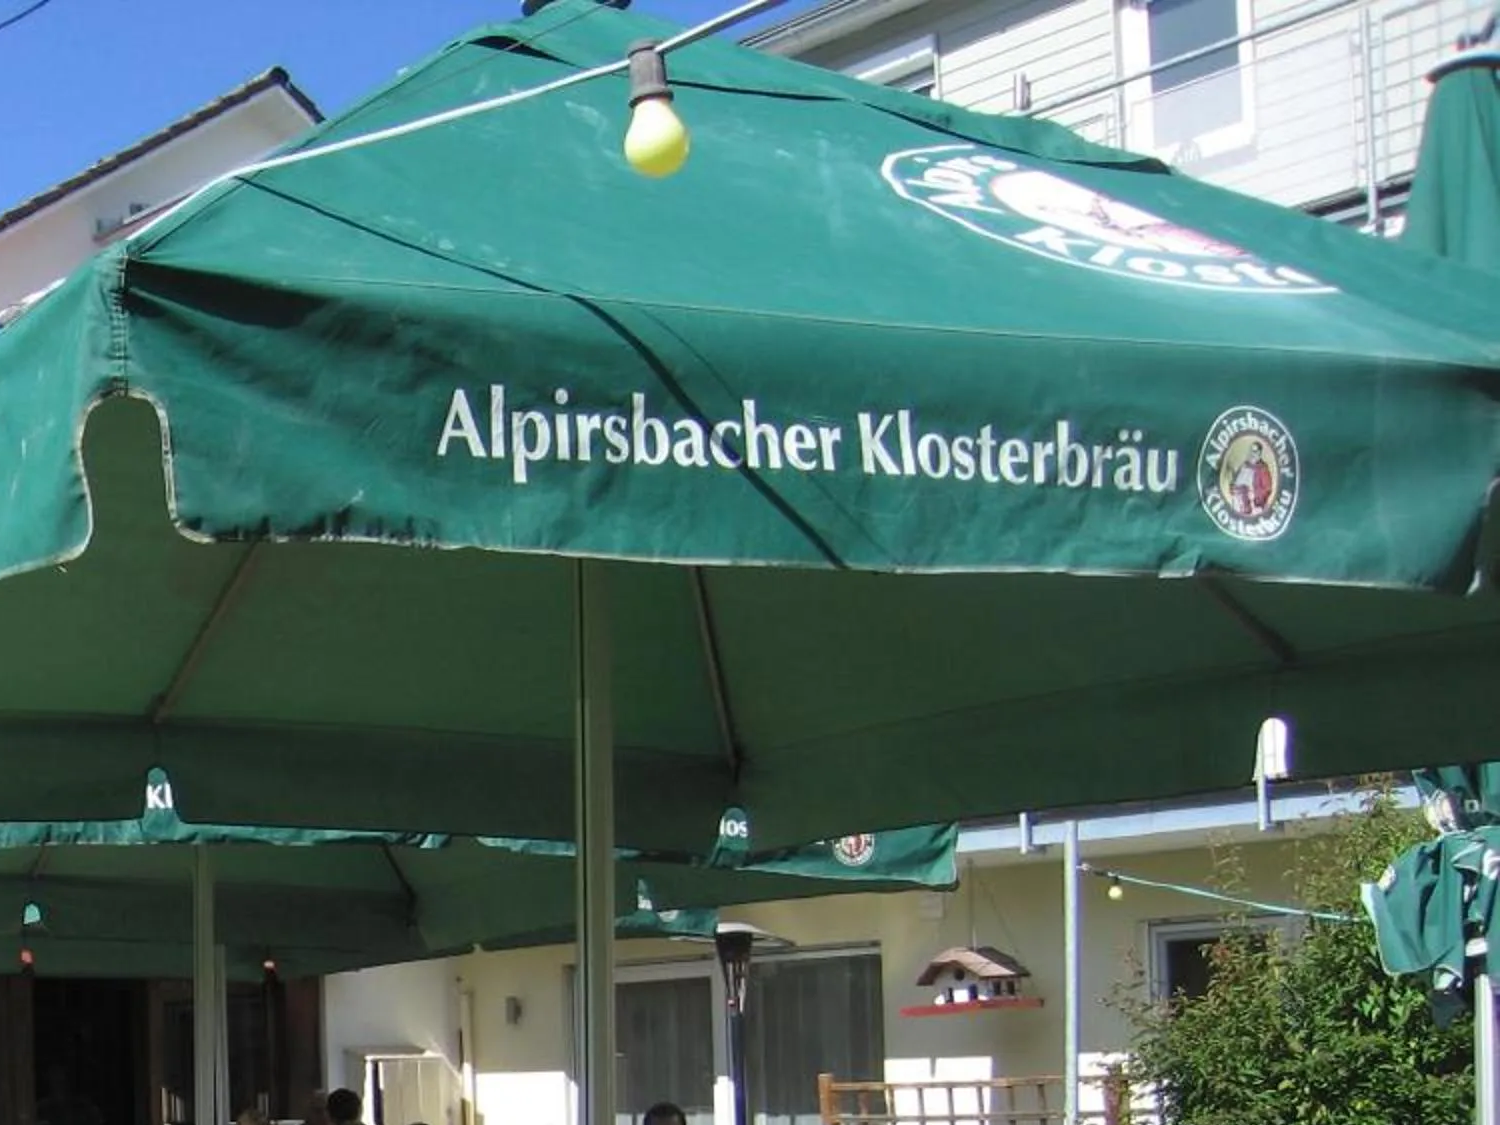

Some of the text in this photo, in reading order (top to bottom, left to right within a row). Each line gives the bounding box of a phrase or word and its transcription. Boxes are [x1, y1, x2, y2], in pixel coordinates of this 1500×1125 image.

[436, 382, 1179, 493] Alpirsbacher Klosterbräu
[1205, 411, 1295, 479] Alpirsbacher
